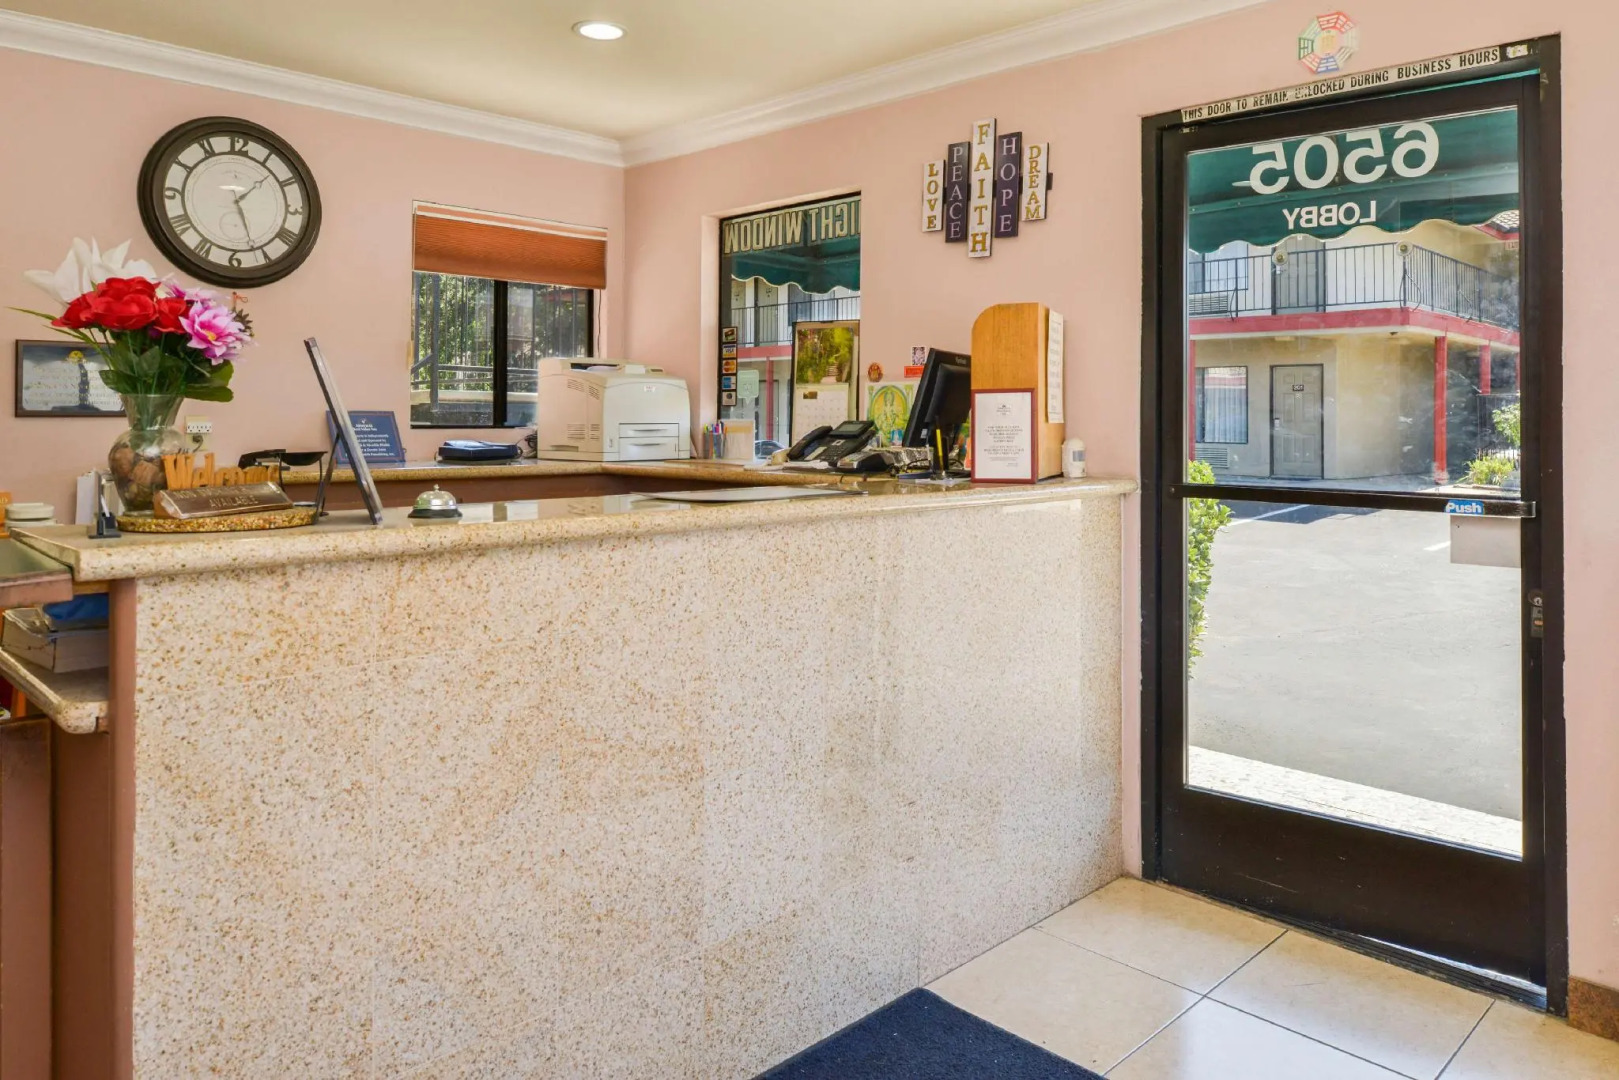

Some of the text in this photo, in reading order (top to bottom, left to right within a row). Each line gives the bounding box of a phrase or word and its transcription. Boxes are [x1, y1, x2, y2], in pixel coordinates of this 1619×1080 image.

[1183, 107, 1203, 120] THIS
[1207, 102, 1232, 116] DOOR
[1236, 98, 1248, 110] TO
[1350, 71, 1389, 88] DURING
[1397, 58, 1452, 79] BUSINESS
[1459, 48, 1499, 68] HOURS
[229, 136, 249, 154] 12
[927, 163, 939, 229] LOVE
[949, 147, 962, 238] PEACE
[970, 123, 991, 253] FAITH
[1000, 137, 1017, 232] HOPE
[1025, 145, 1041, 219] DREAM
[161, 452, 280, 489] Welcome
[1445, 502, 1482, 513] Push
